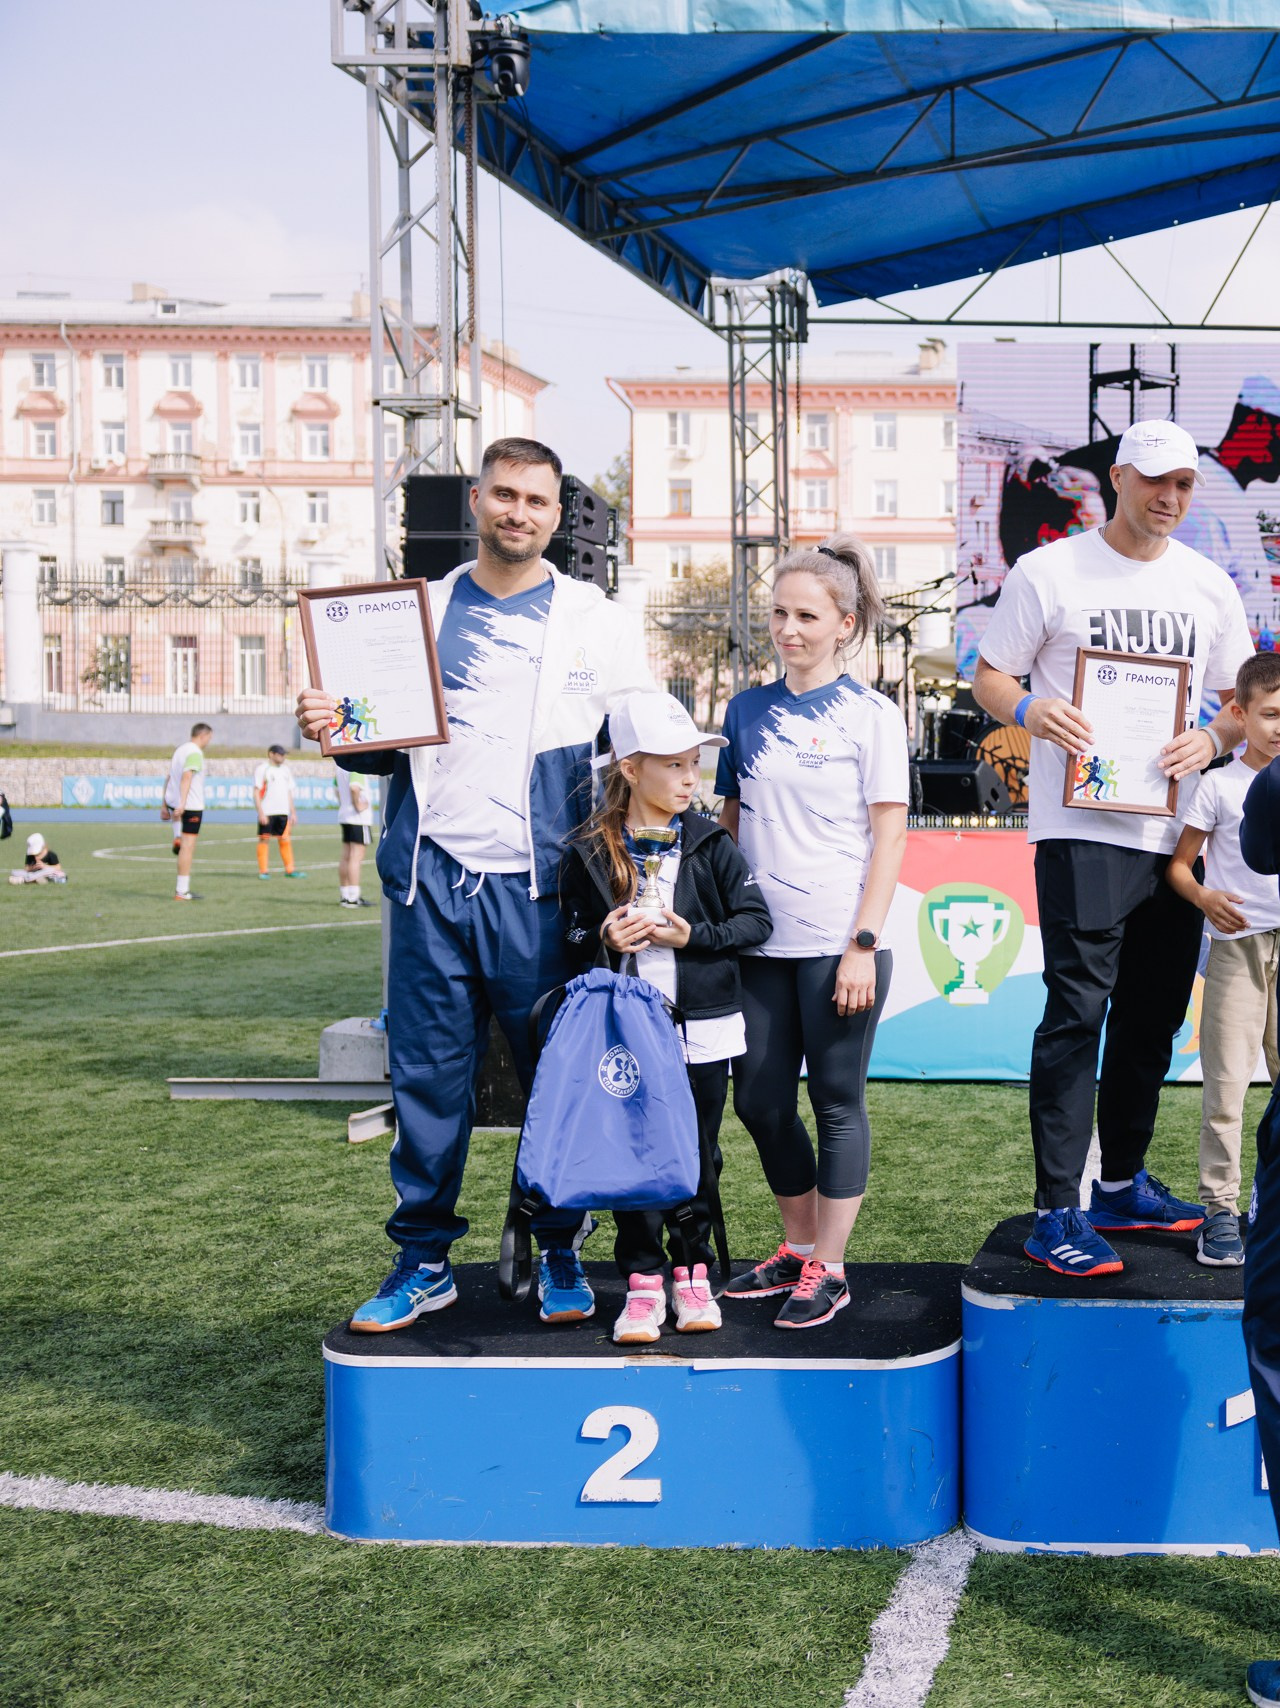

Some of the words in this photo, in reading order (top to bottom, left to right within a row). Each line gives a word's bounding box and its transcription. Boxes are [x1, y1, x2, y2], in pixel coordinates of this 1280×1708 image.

[358, 600, 418, 614] ГРАМОТА
[1088, 609, 1194, 657] ENJOY
[1125, 672, 1177, 687] ГРАМОТА
[795, 751, 831, 762] КОМОС
[580, 1405, 663, 1503] 2
